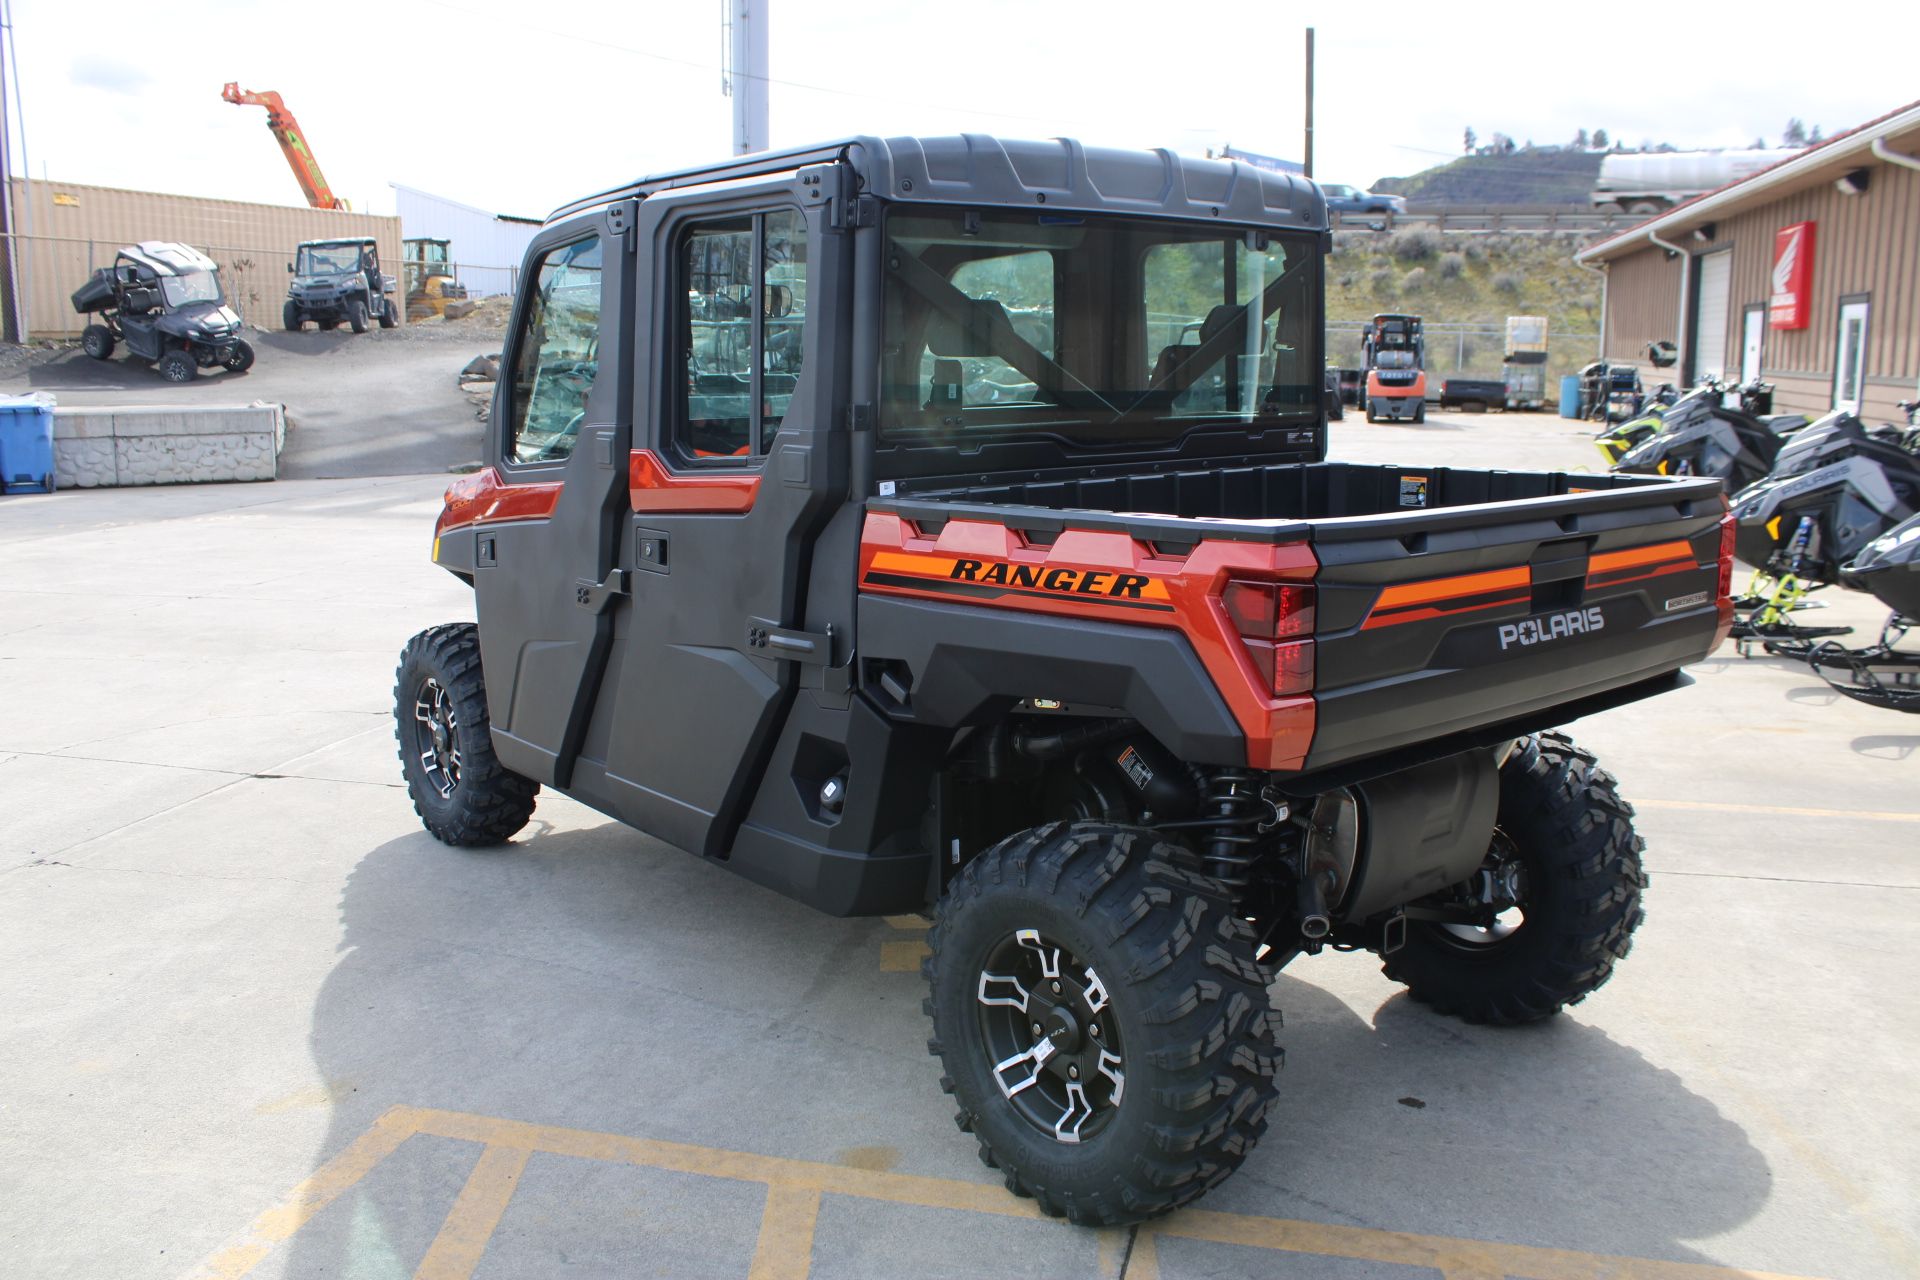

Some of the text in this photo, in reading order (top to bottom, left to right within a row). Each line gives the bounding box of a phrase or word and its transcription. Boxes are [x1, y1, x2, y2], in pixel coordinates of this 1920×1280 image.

[1782, 465, 1851, 494] POLARIS
[950, 559, 1150, 598] RANGER
[1498, 606, 1605, 650] POLARIS
